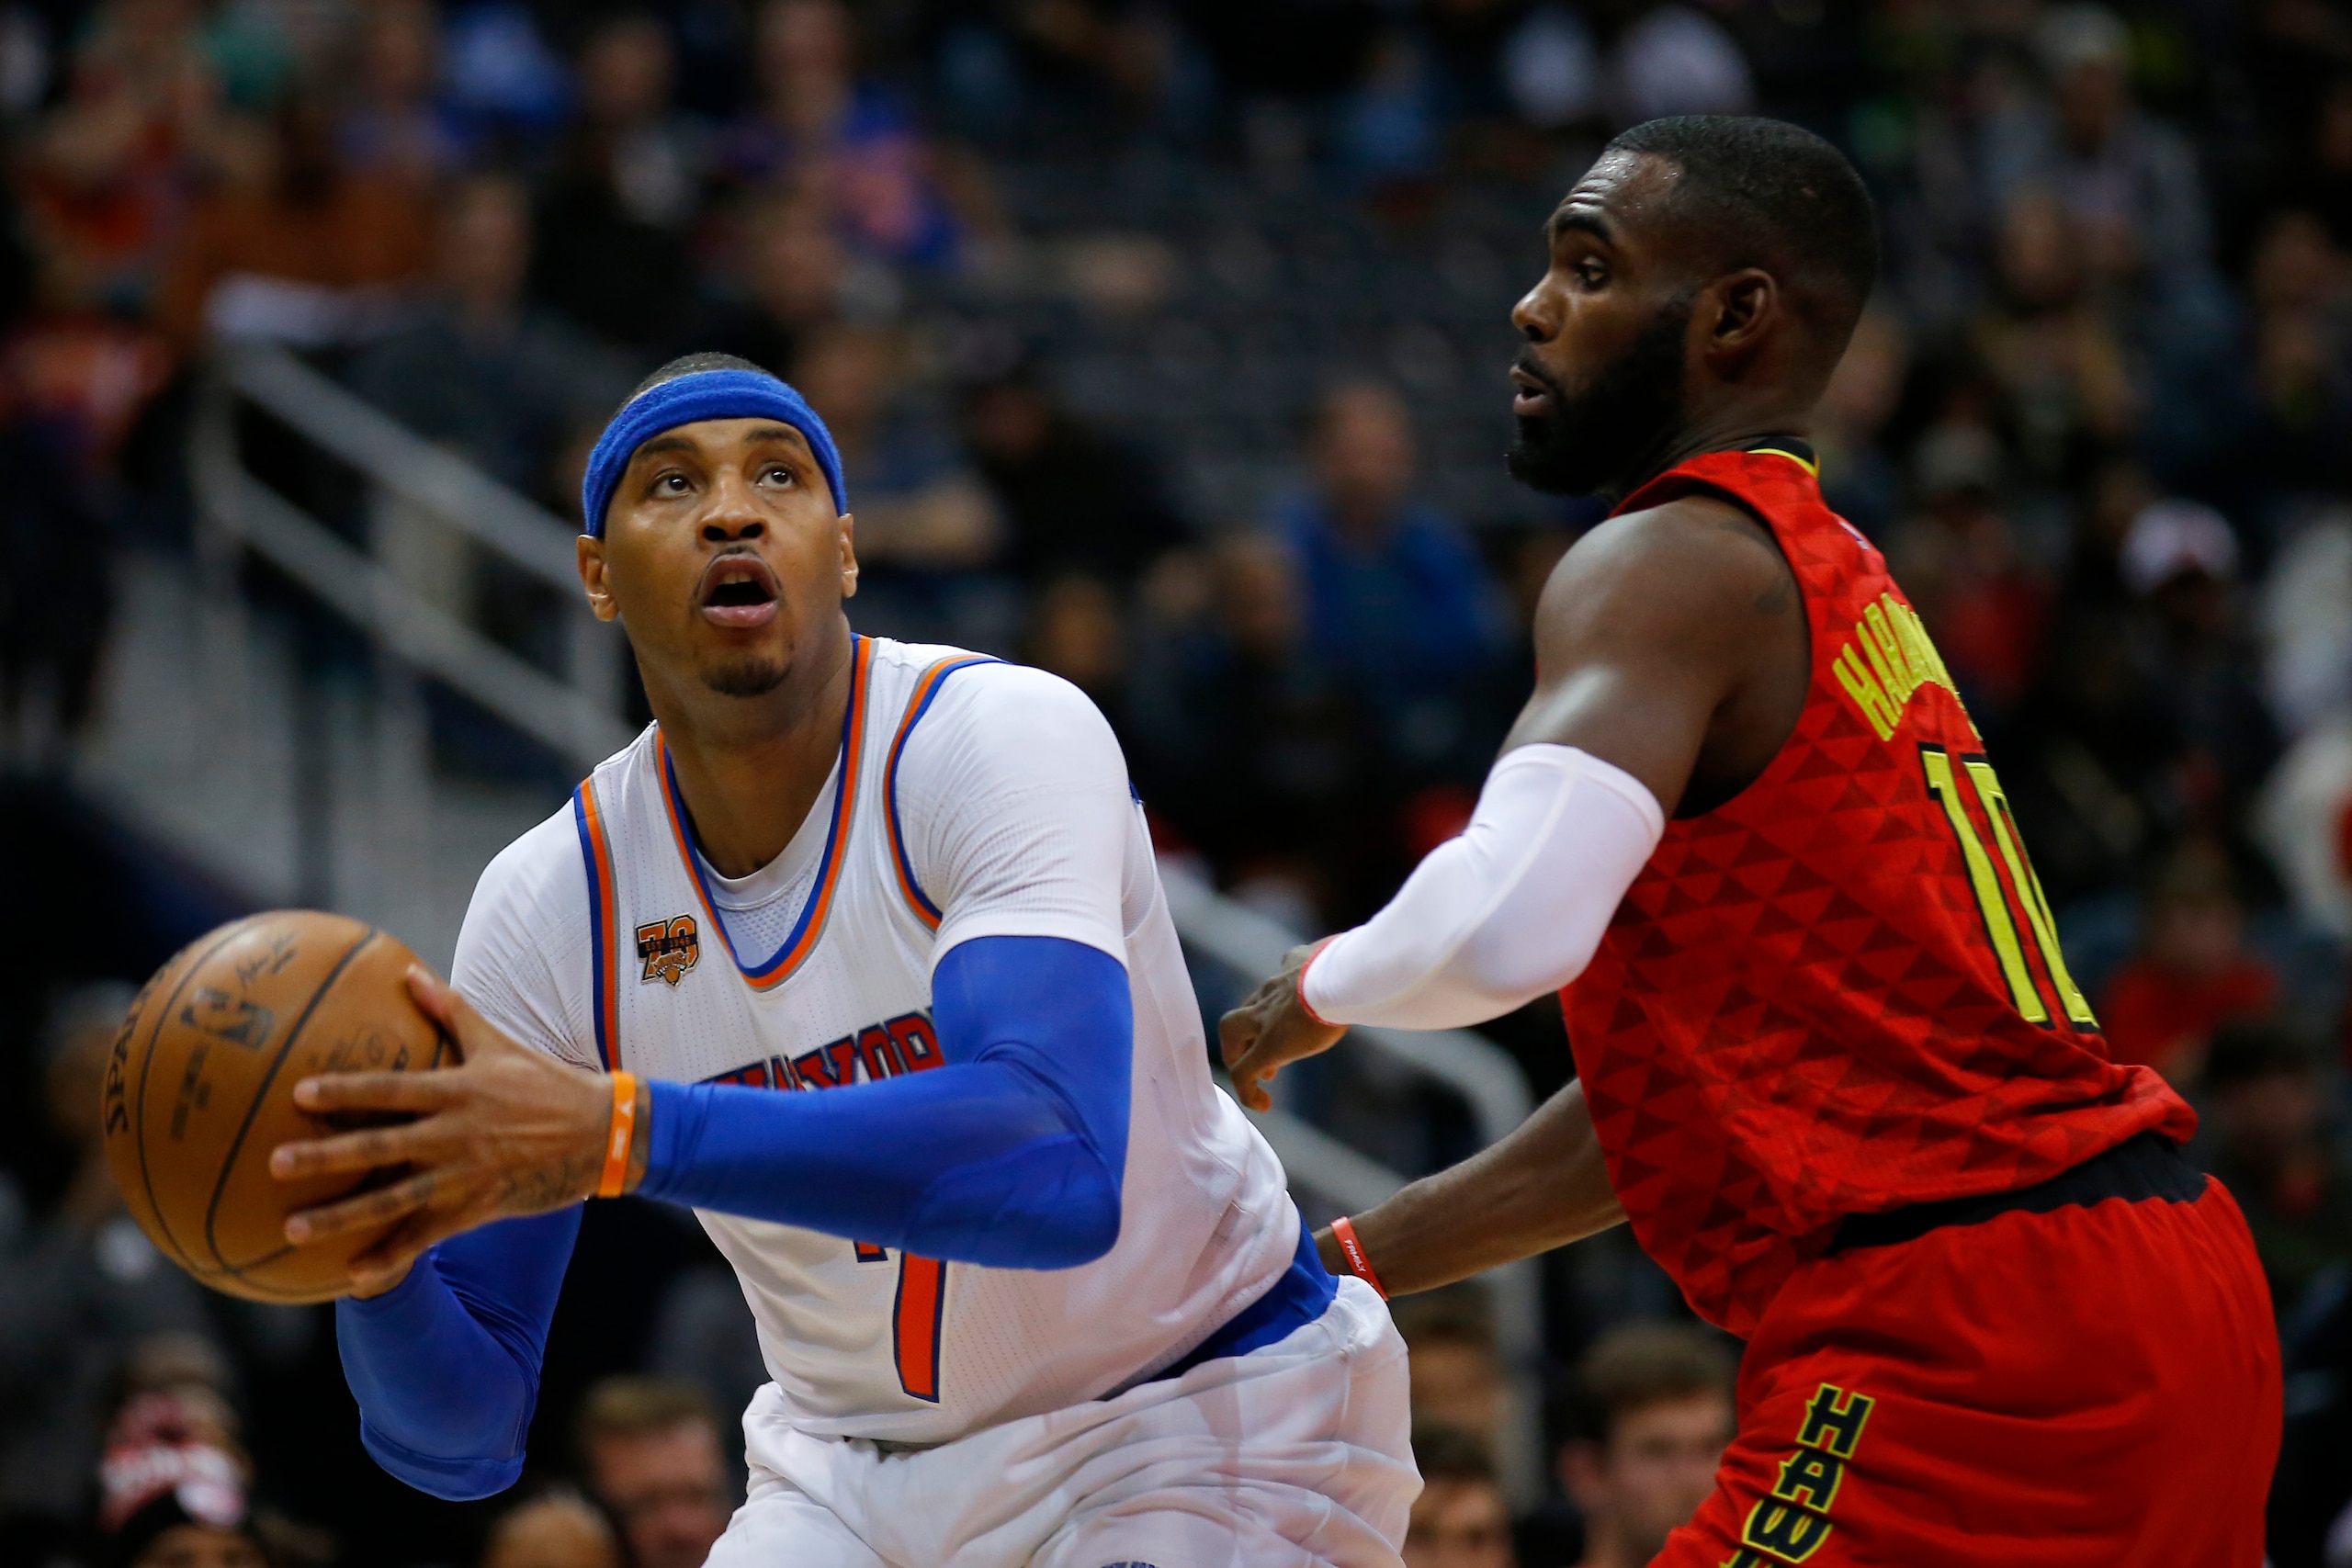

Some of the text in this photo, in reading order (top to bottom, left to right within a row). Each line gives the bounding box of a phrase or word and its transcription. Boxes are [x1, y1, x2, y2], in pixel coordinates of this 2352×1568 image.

[635, 915, 699, 981] 70
[793, 1008, 946, 1091] YOR
[1344, 1238, 1366, 1272] FAMILY
[1719, 1382, 1875, 1568] HAW
